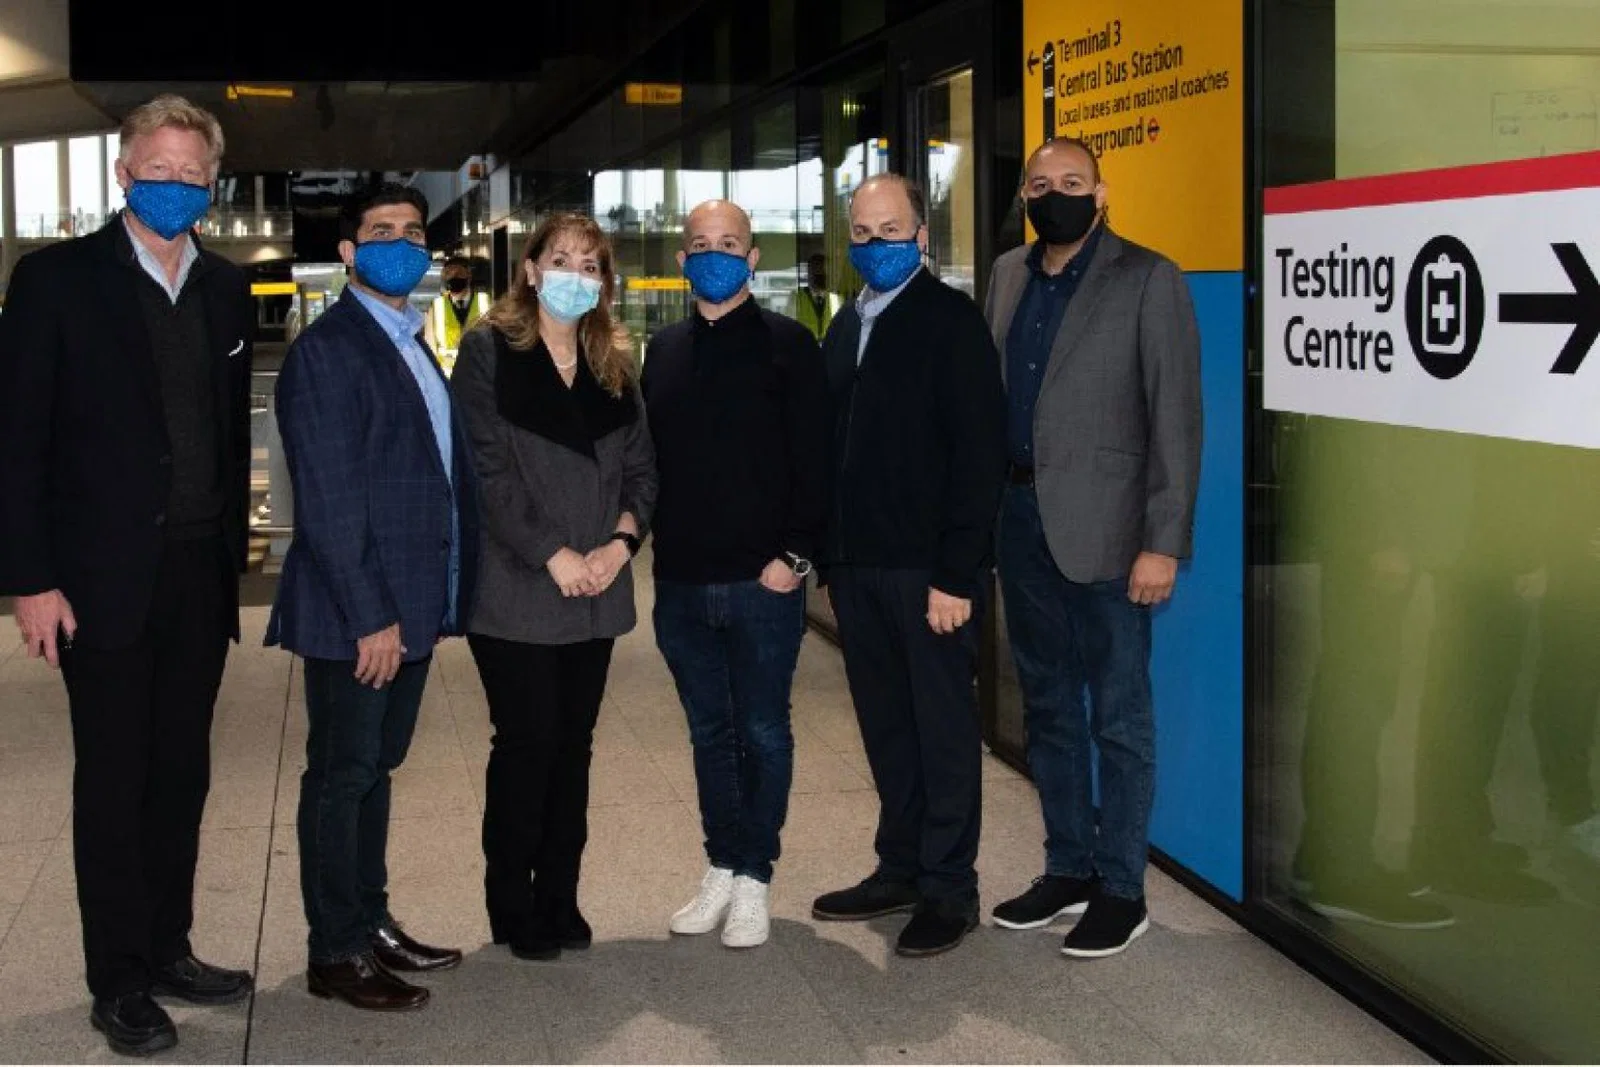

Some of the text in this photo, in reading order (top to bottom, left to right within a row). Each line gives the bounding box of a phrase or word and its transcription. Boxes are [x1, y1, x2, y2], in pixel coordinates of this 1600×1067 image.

[1057, 18, 1122, 63] Terminal 3
[1058, 43, 1183, 98] Central Bus Station
[1058, 68, 1230, 127] Local buses and national coaches
[1275, 243, 1395, 313] Testing
[1284, 316, 1395, 373] Centre
